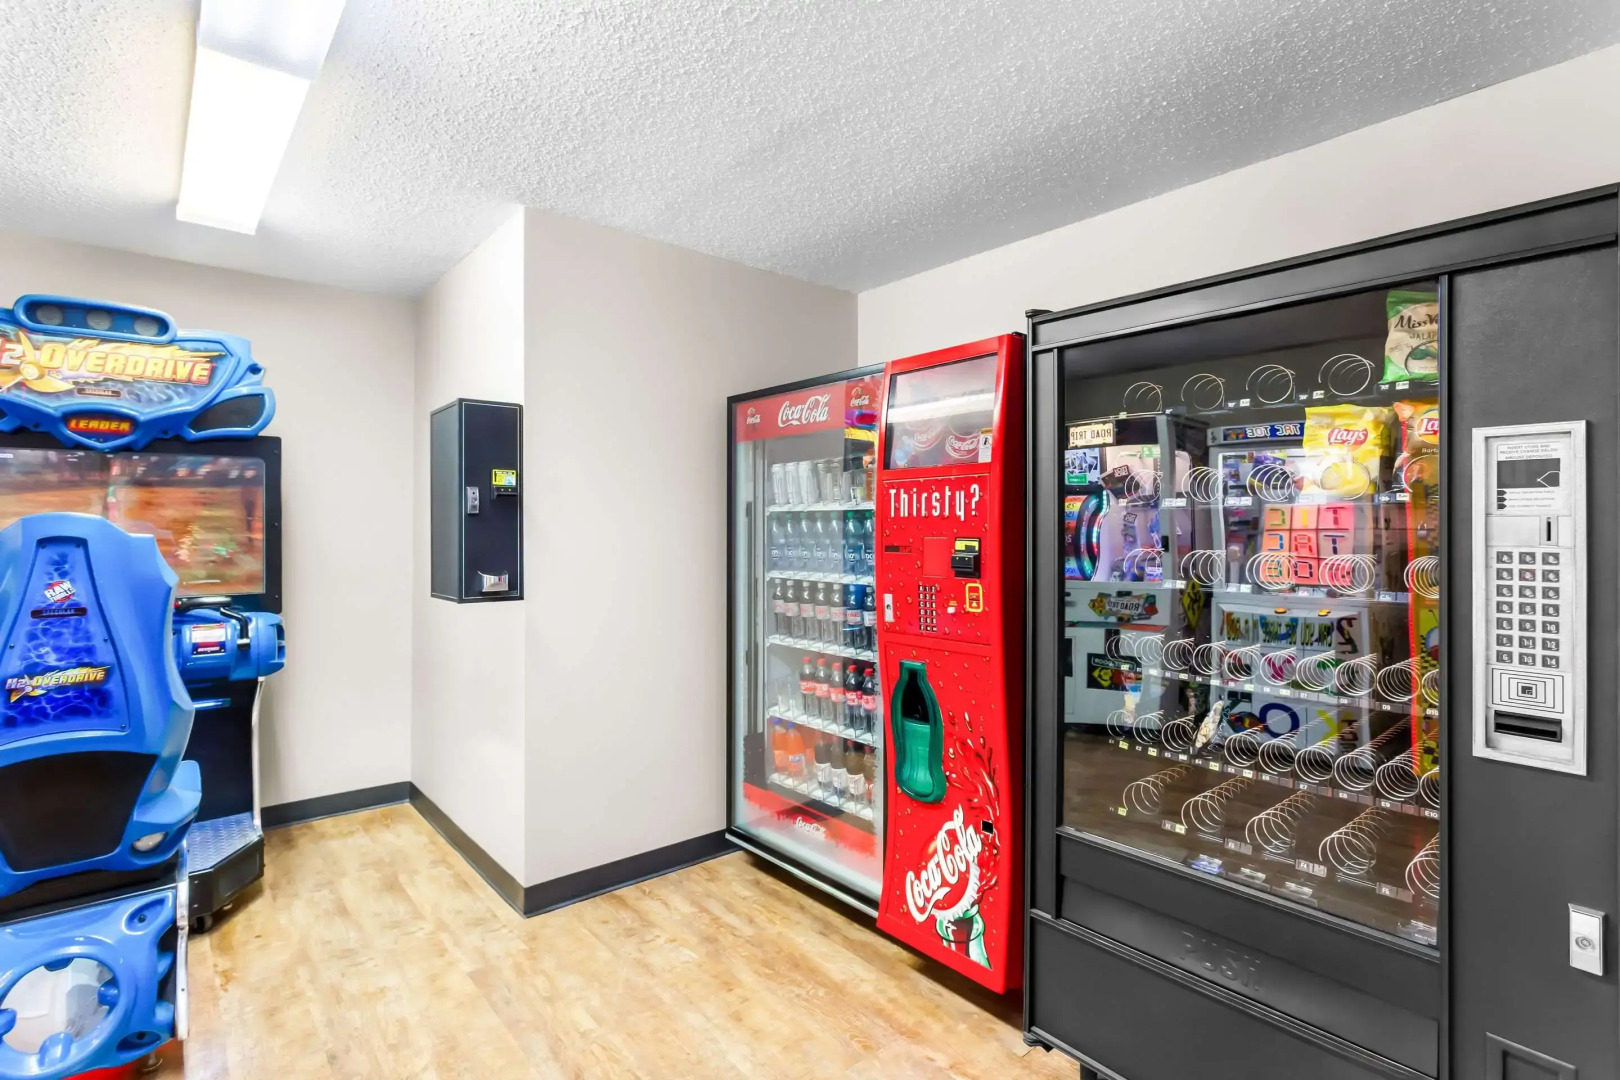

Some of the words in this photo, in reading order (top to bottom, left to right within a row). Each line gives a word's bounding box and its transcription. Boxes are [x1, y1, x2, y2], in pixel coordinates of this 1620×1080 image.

[1394, 314, 1426, 329] Miss
[0, 338, 24, 366] 2
[40, 342, 215, 385] OVERDRIVE
[778, 393, 831, 428] Coca-Cola
[70, 418, 131, 431] LEADER
[1420, 418, 1438, 436] La
[889, 483, 980, 522] Thirsty?
[44, 581, 73, 599] RAW
[5, 678, 28, 689] H2
[33, 671, 106, 687] OVERDRIVE
[1424, 810, 1438, 818] E10
[905, 803, 982, 922] Coca-Cola
